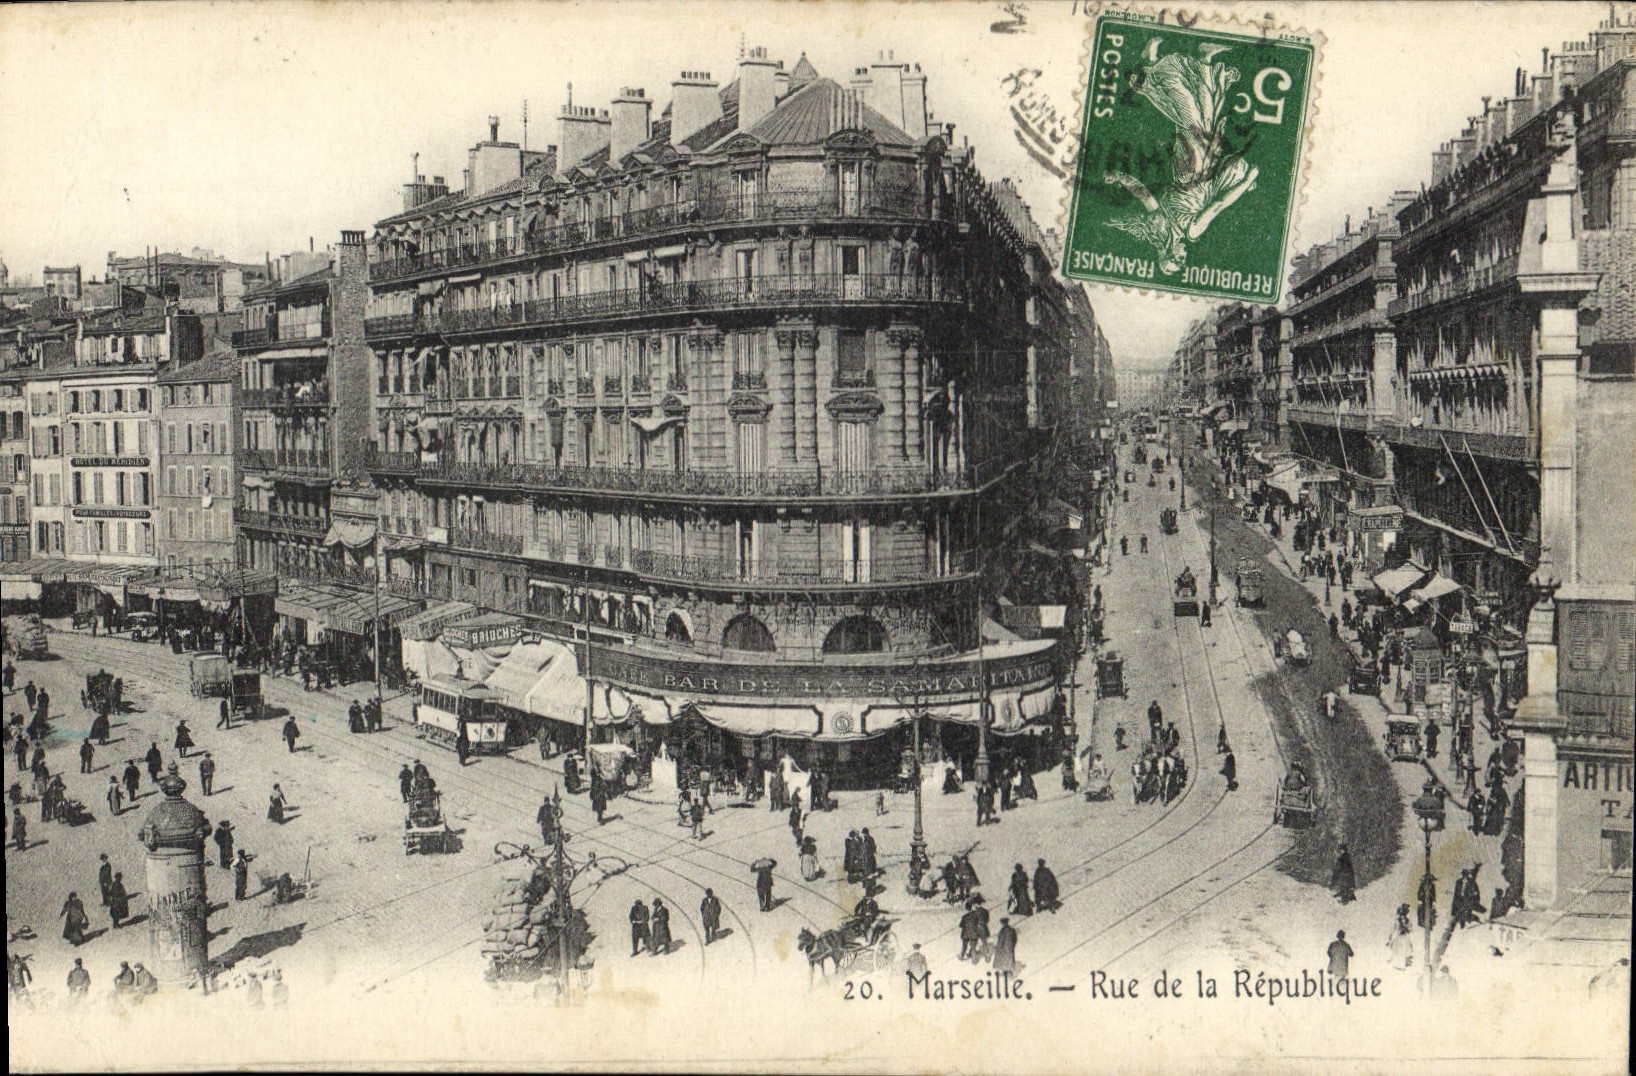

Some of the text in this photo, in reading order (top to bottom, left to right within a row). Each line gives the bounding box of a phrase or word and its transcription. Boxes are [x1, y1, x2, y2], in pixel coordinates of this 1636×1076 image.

[1094, 33, 1124, 119] POSTES
[1073, 250, 1156, 279] FRANÇAISE
[471, 623, 523, 645] BRIOCHES
[664, 673, 719, 691] BAR
[738, 679, 780, 693] DE
[803, 679, 847, 694] LA
